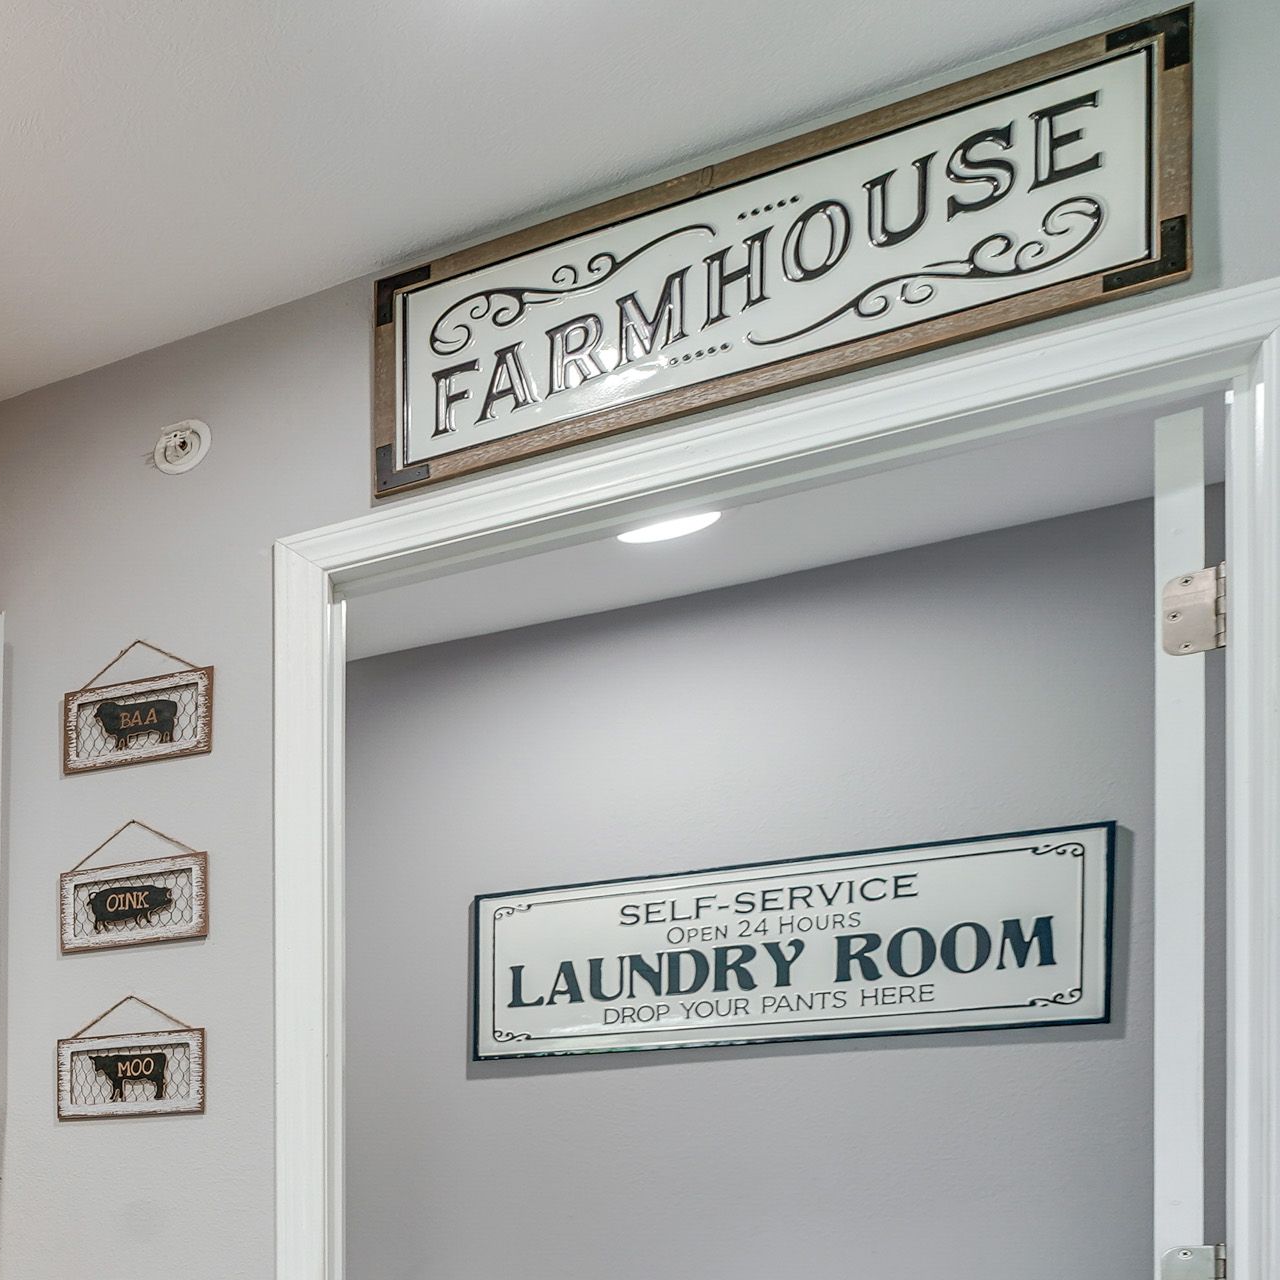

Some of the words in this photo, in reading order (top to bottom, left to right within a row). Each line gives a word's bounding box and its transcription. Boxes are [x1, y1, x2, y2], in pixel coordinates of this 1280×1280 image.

[431, 90, 1103, 438] FARMHOUSE
[120, 708, 158, 729] BAA
[106, 891, 150, 911] OINK
[620, 872, 919, 926] SELF-SERVICE
[666, 925, 729, 944] OPEN
[738, 918, 769, 938] 24
[779, 911, 862, 935] HOURS
[507, 938, 806, 1008] LAUNDRY
[833, 915, 1057, 983] ROOM
[603, 1003, 670, 1025] DROP
[681, 998, 749, 1020] YOUR
[762, 991, 847, 1014] PANTS
[860, 984, 935, 1007] HERE
[117, 1057, 154, 1077] MOO
